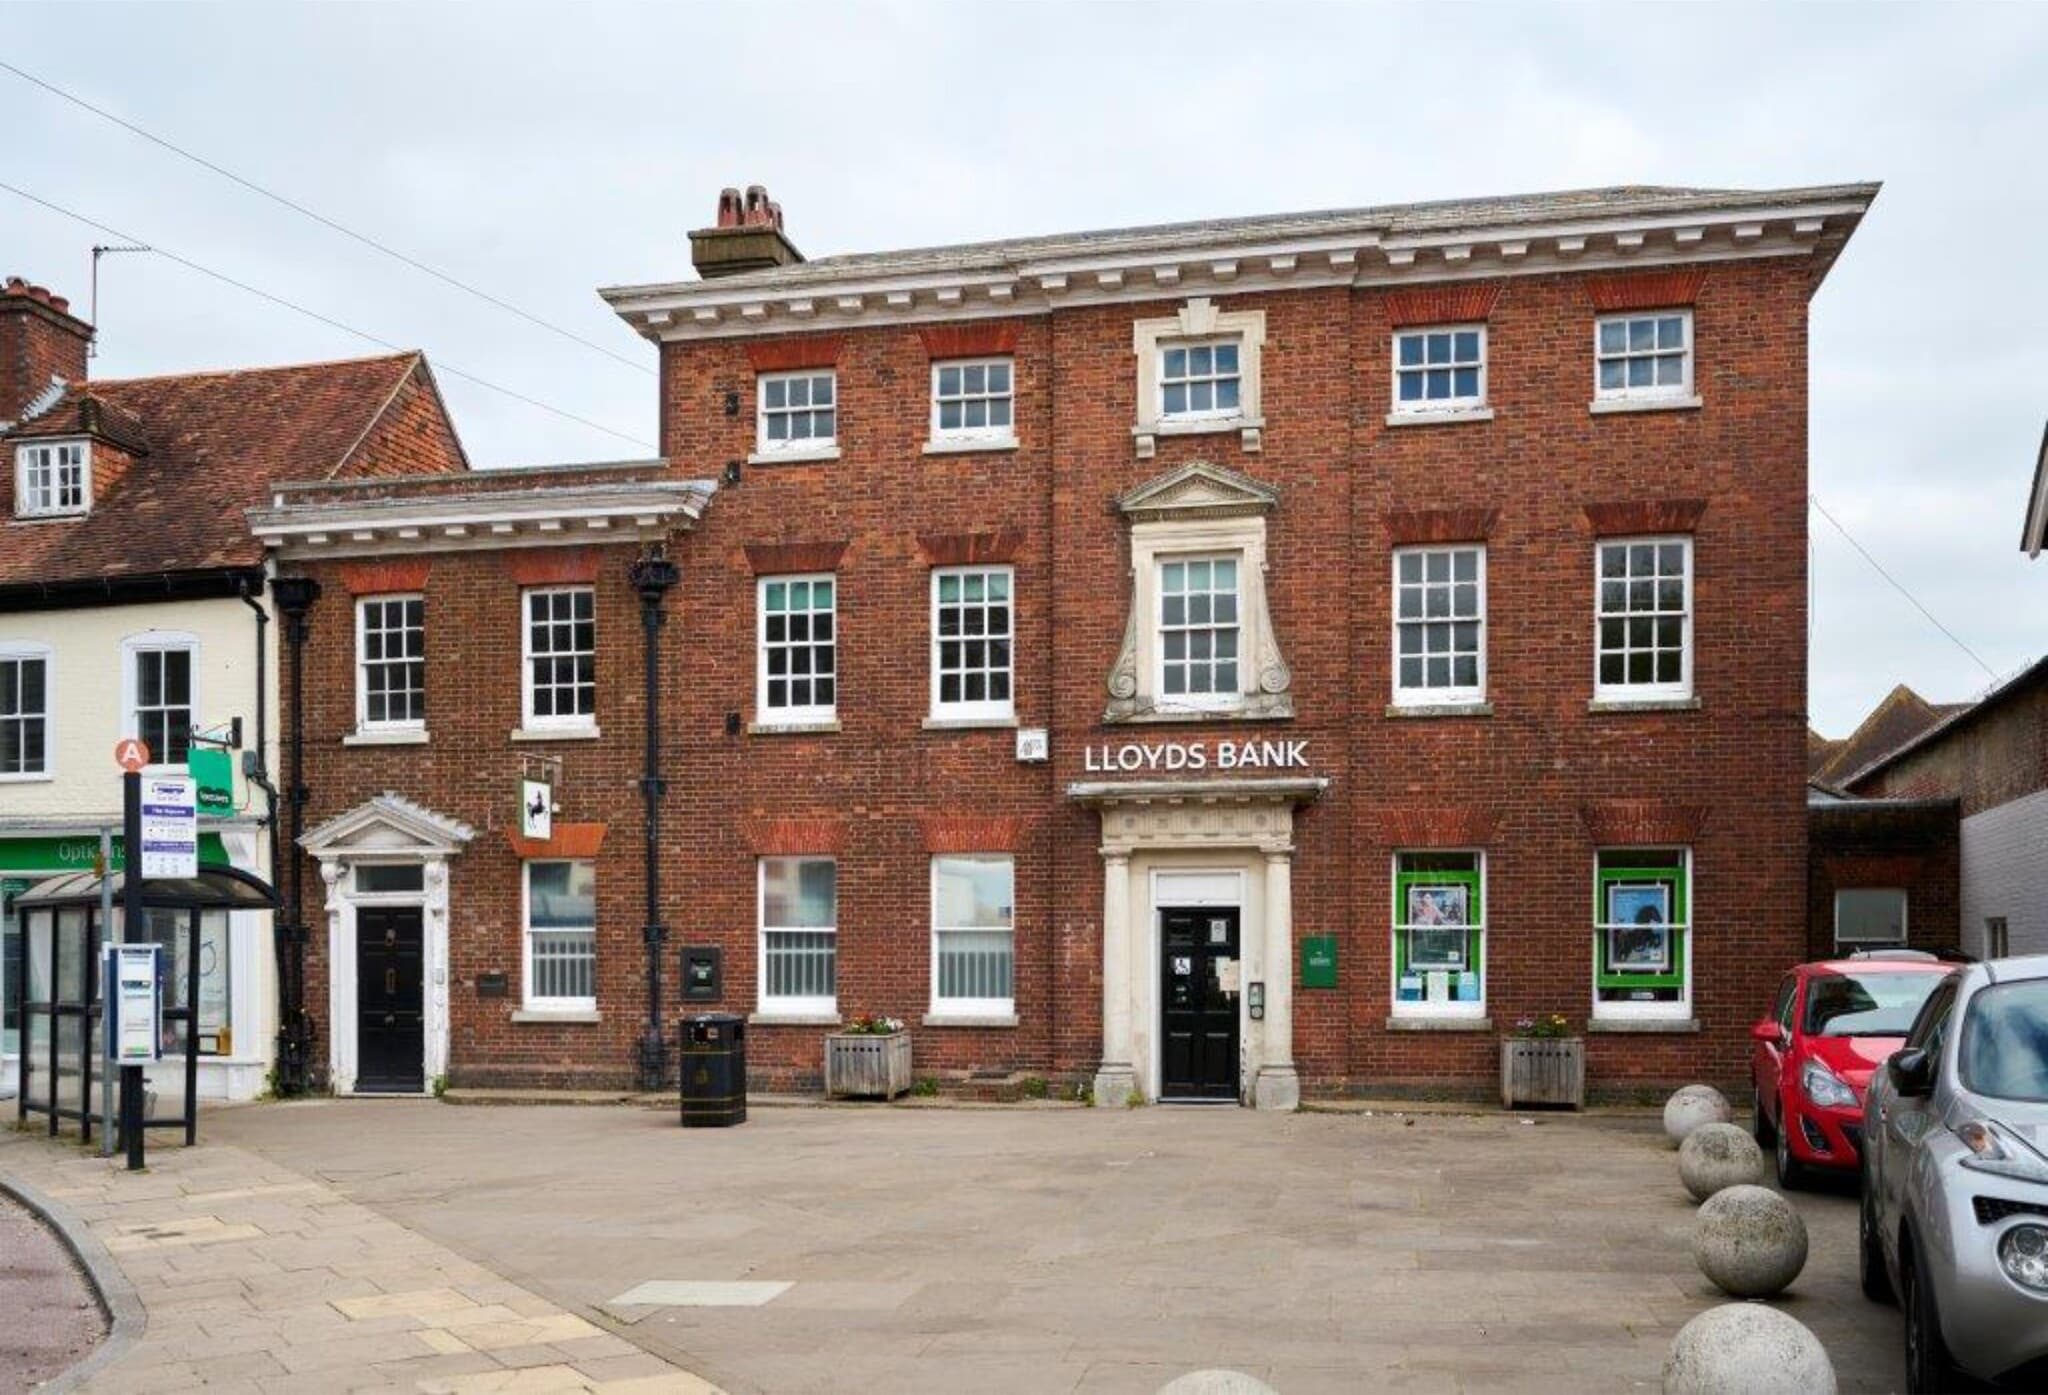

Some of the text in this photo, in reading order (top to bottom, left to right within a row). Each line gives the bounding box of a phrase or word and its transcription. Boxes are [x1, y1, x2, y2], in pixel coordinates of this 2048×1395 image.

[122, 743, 143, 763] A
[1085, 741, 1309, 771] LLOYDS BANK
